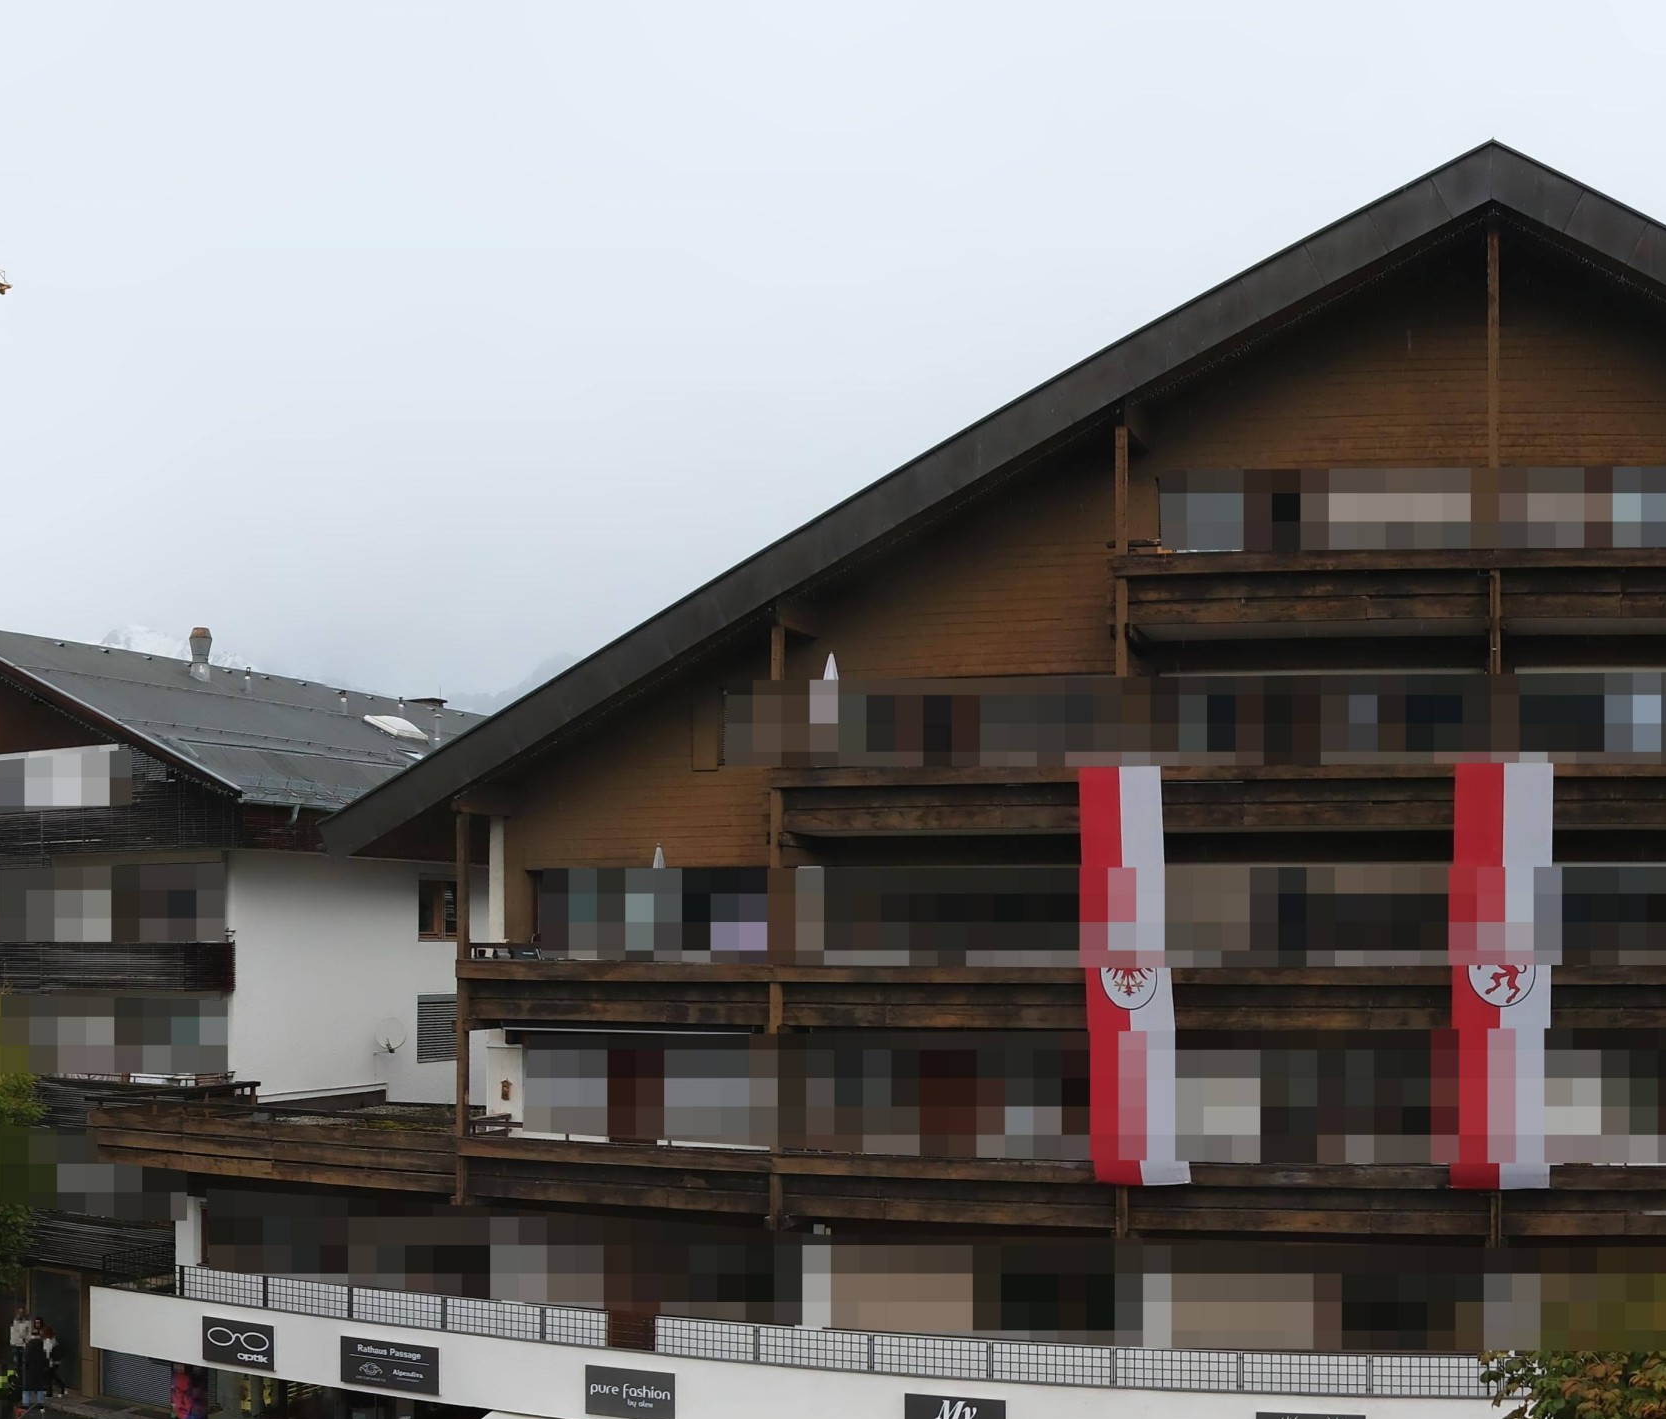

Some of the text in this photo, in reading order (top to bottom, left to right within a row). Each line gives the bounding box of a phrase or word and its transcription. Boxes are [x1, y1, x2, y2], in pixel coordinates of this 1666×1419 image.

[237, 1352, 269, 1364] optik
[357, 1343, 422, 1360] Rathaus Passage
[590, 1383, 671, 1400] pure fashion
[627, 1399, 653, 1408] by alex
